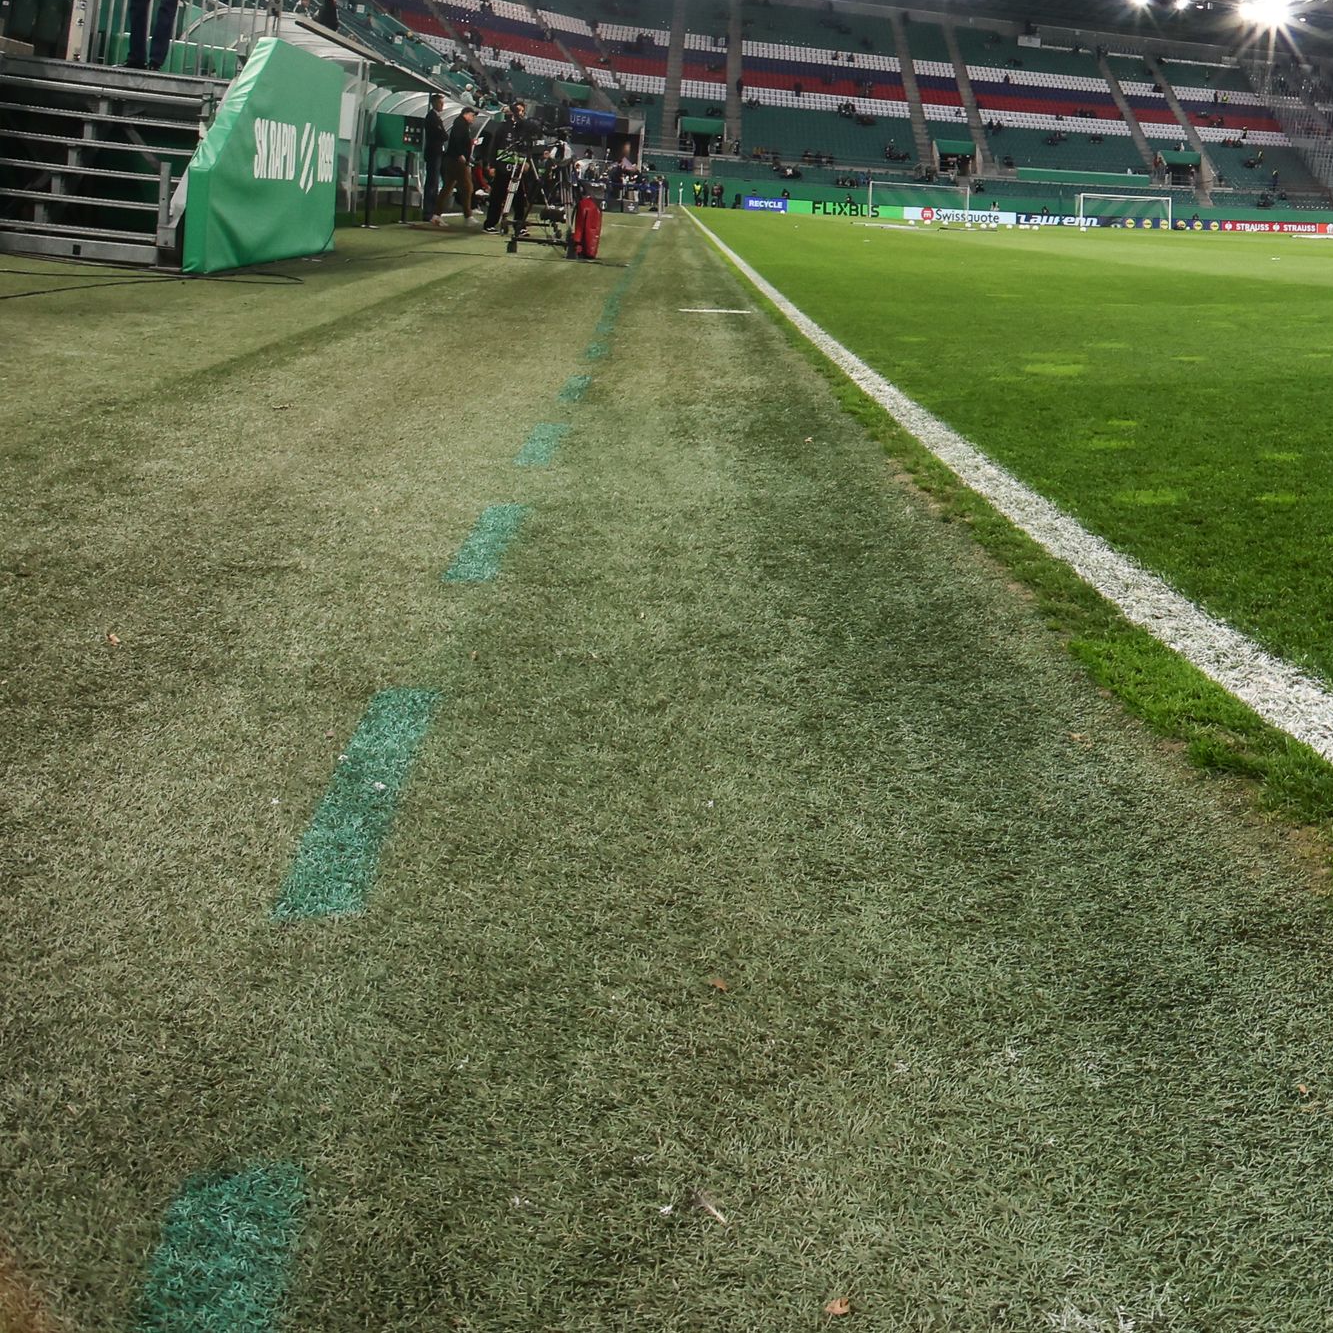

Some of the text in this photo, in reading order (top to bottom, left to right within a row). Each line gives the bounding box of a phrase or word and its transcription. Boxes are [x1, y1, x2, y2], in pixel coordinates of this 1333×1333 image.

[569, 114, 591, 126] UEFA
[268, 120, 297, 181] RAPID
[748, 199, 783, 209] RECYCLE
[935, 209, 1000, 225] Swissquote
[1236, 222, 1269, 232] STRAUSS
[1283, 223, 1316, 233] STRAUSS
